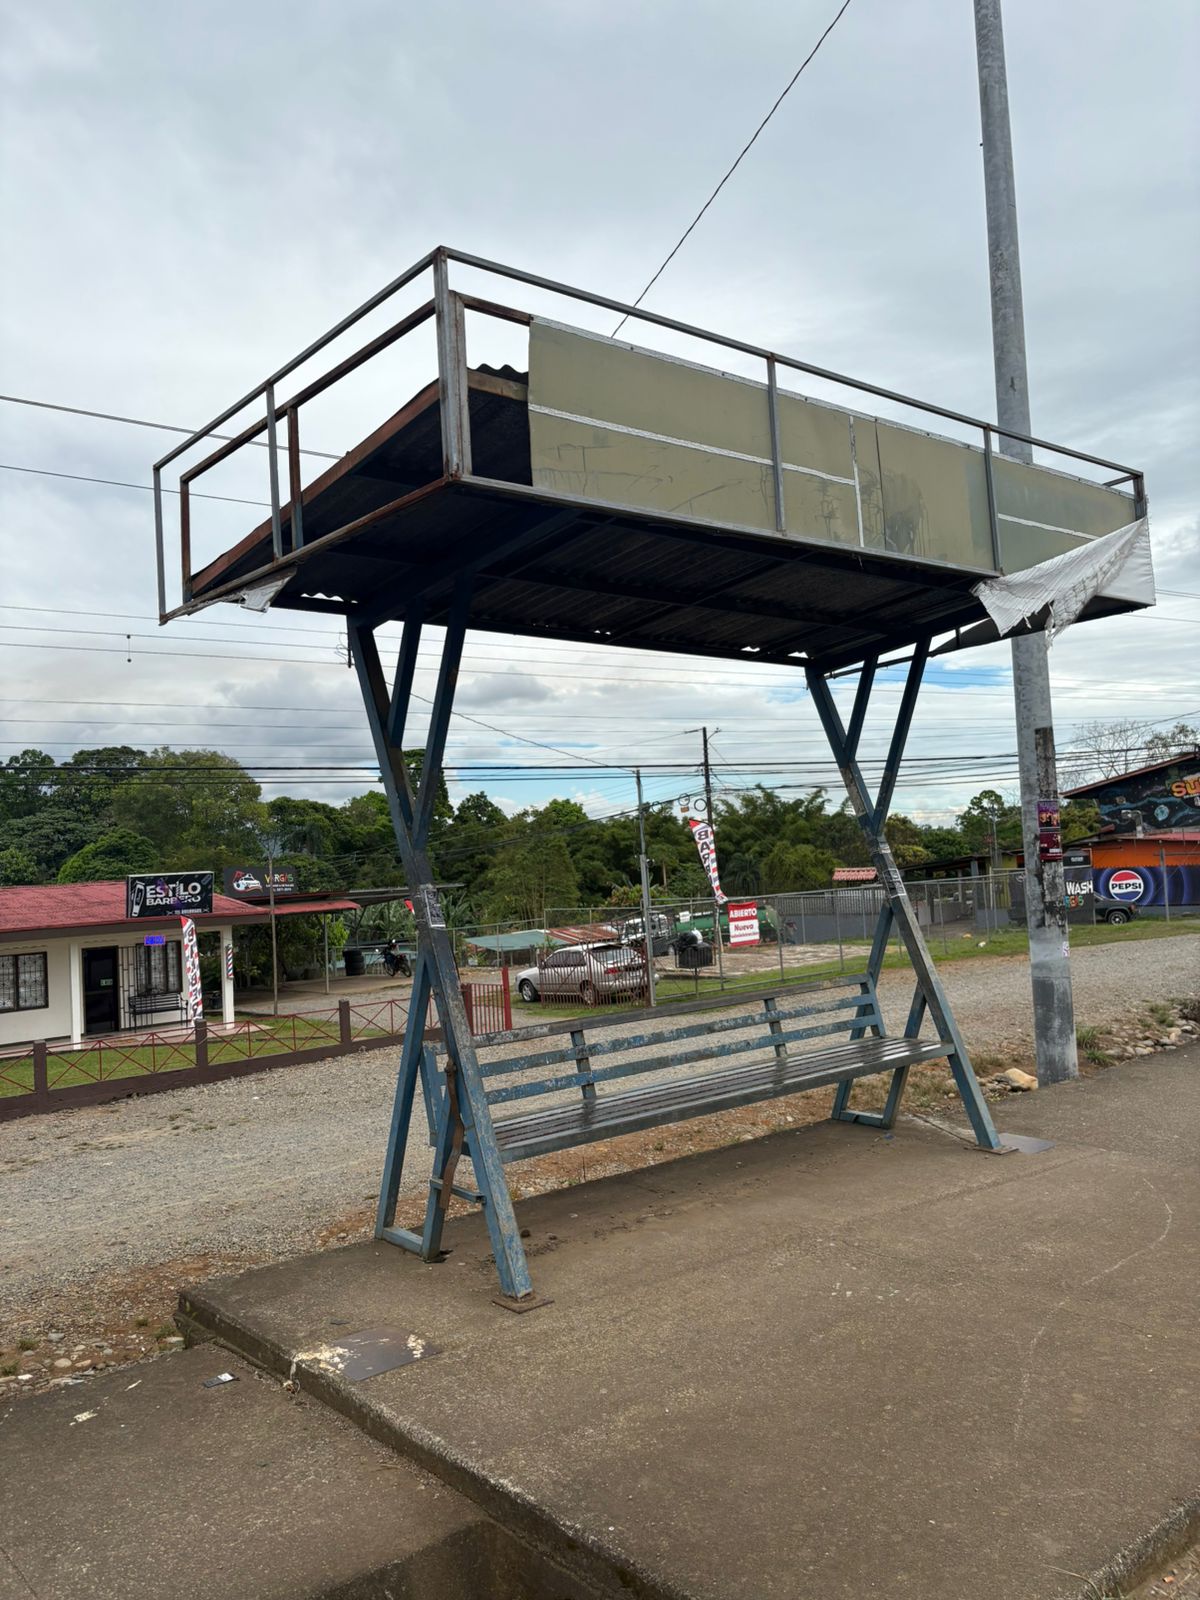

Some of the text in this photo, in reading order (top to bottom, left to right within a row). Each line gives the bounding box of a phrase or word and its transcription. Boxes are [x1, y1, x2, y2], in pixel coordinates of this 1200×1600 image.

[146, 881, 201, 898] ESTILO
[1066, 880, 1094, 895] WASH
[1111, 882, 1142, 890] PEPSI
[146, 895, 201, 906] BARBERO
[729, 907, 757, 918] ABIERTO
